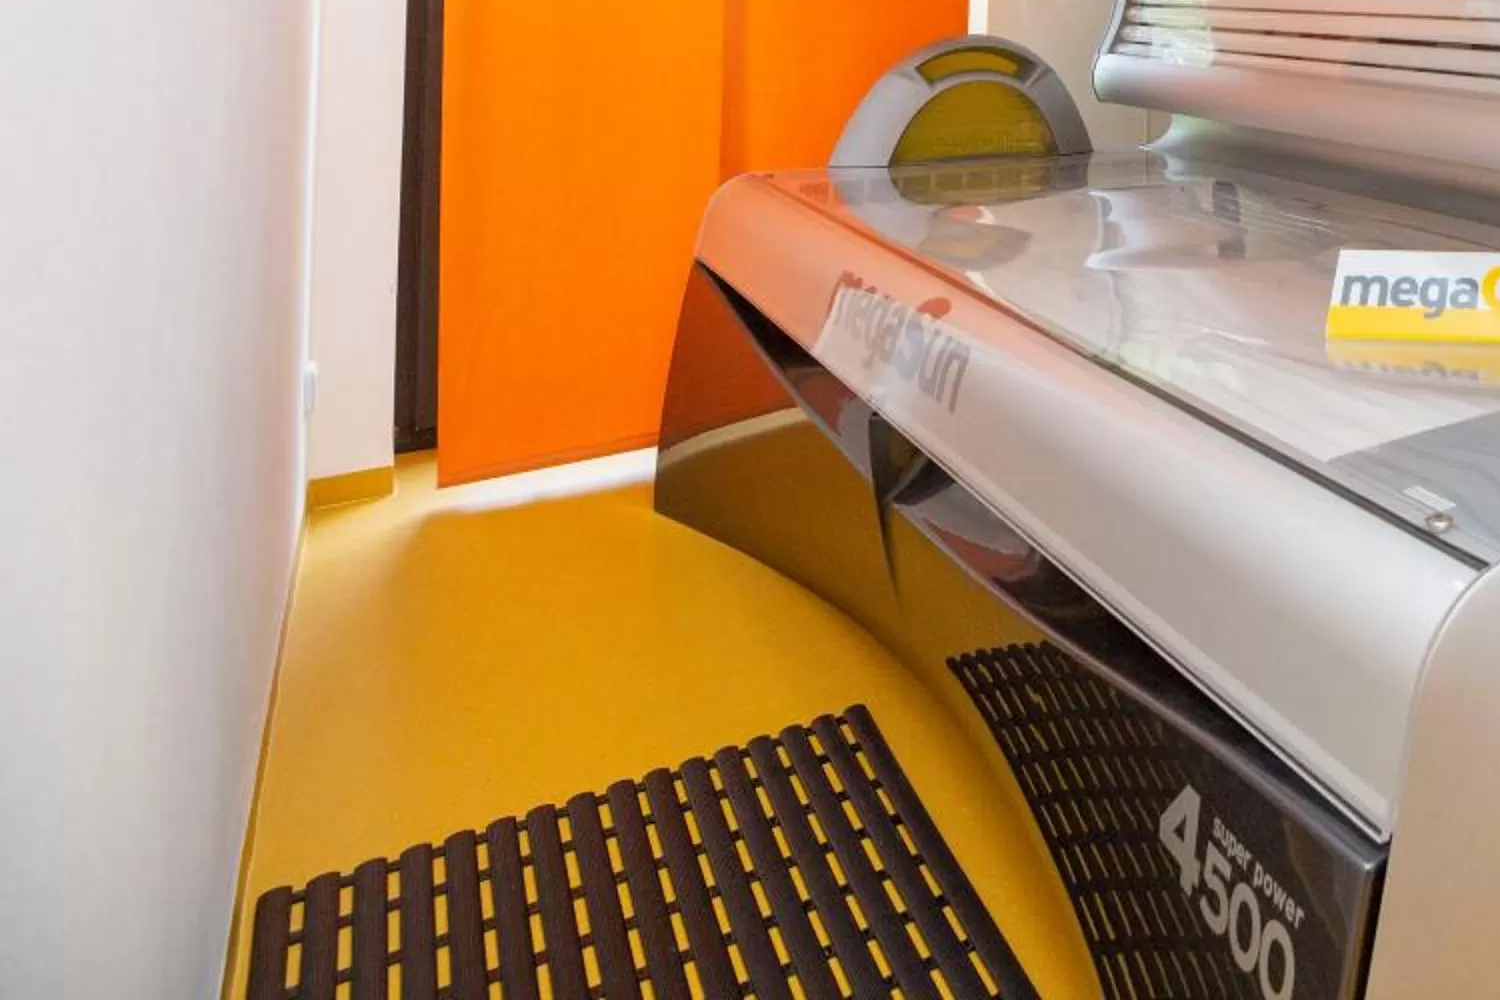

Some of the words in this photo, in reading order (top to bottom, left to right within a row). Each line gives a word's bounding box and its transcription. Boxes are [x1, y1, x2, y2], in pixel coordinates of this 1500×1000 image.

[1159, 784, 1295, 1000] 4500
[1212, 816, 1253, 871] super
[1253, 862, 1305, 929] power
